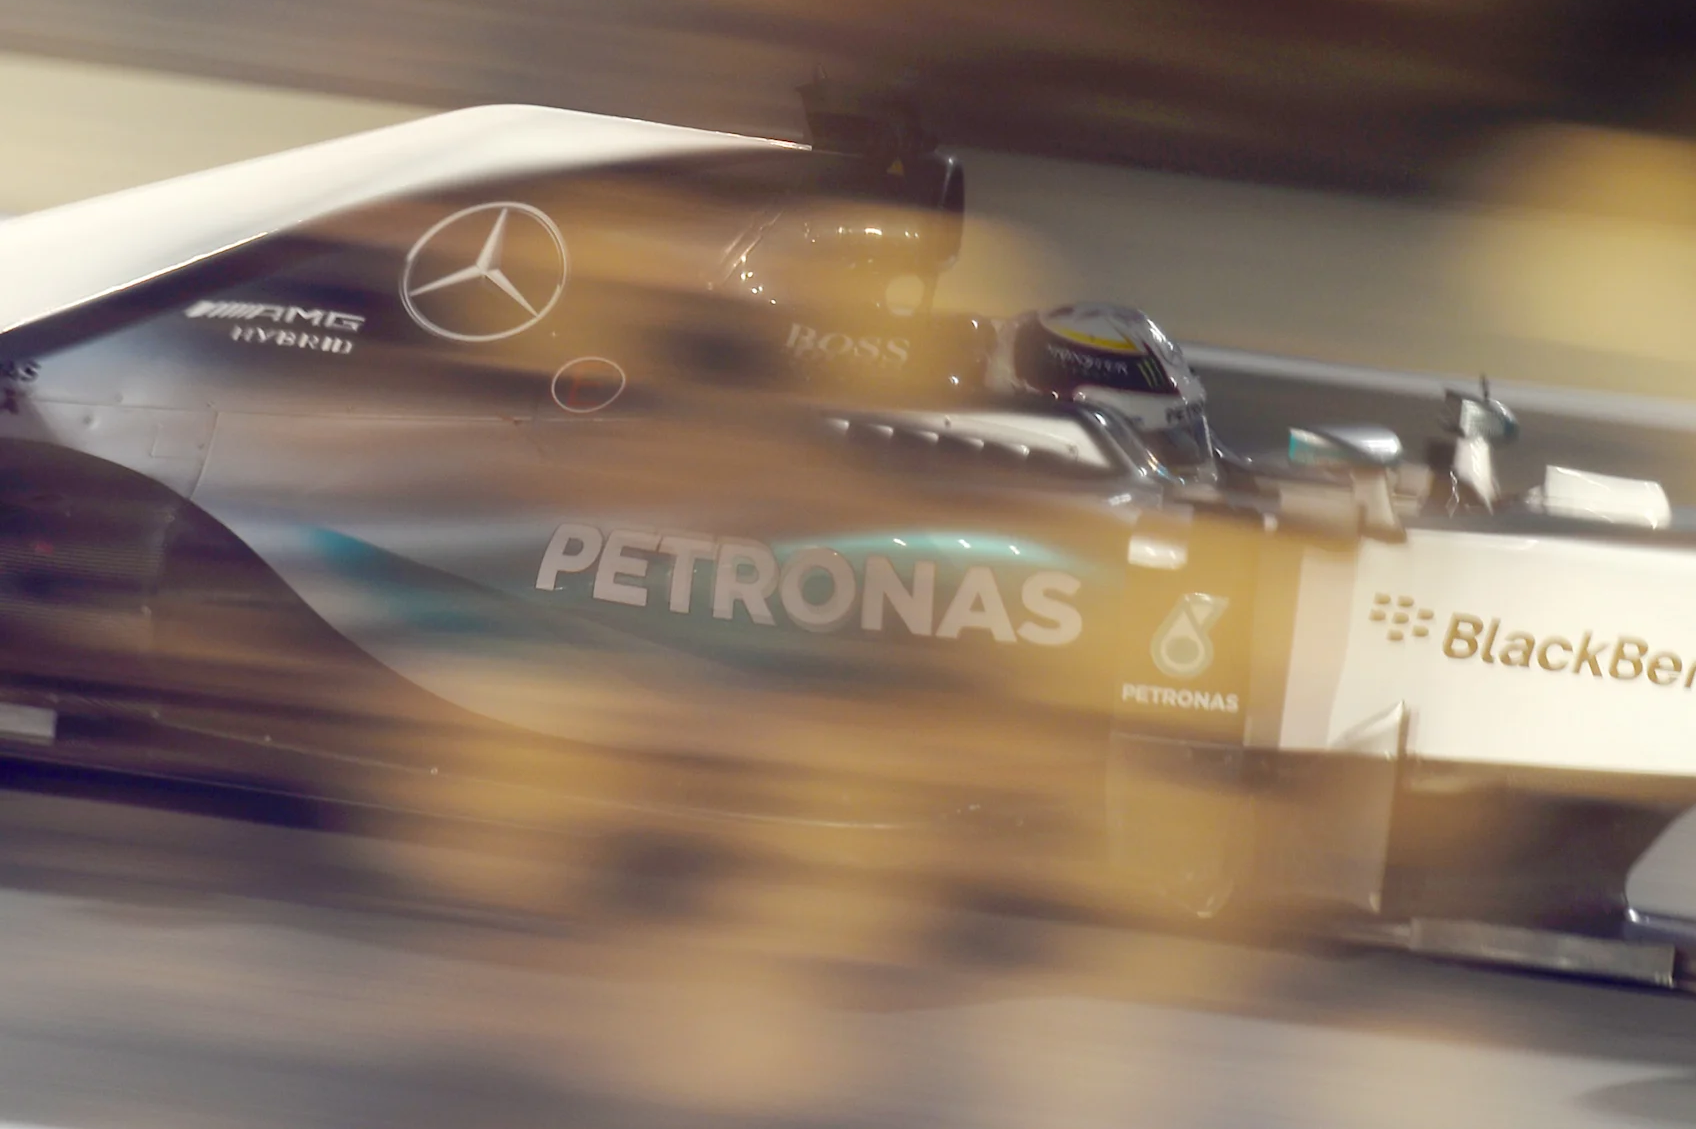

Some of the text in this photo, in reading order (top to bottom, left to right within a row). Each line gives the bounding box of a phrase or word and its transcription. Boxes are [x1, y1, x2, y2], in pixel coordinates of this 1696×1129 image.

[248, 303, 366, 332] AMG
[230, 325, 353, 354] HYBRID
[785, 323, 911, 363] BOSS
[535, 523, 1083, 647] PETRONAS
[1122, 683, 1239, 713] PETRONAS
